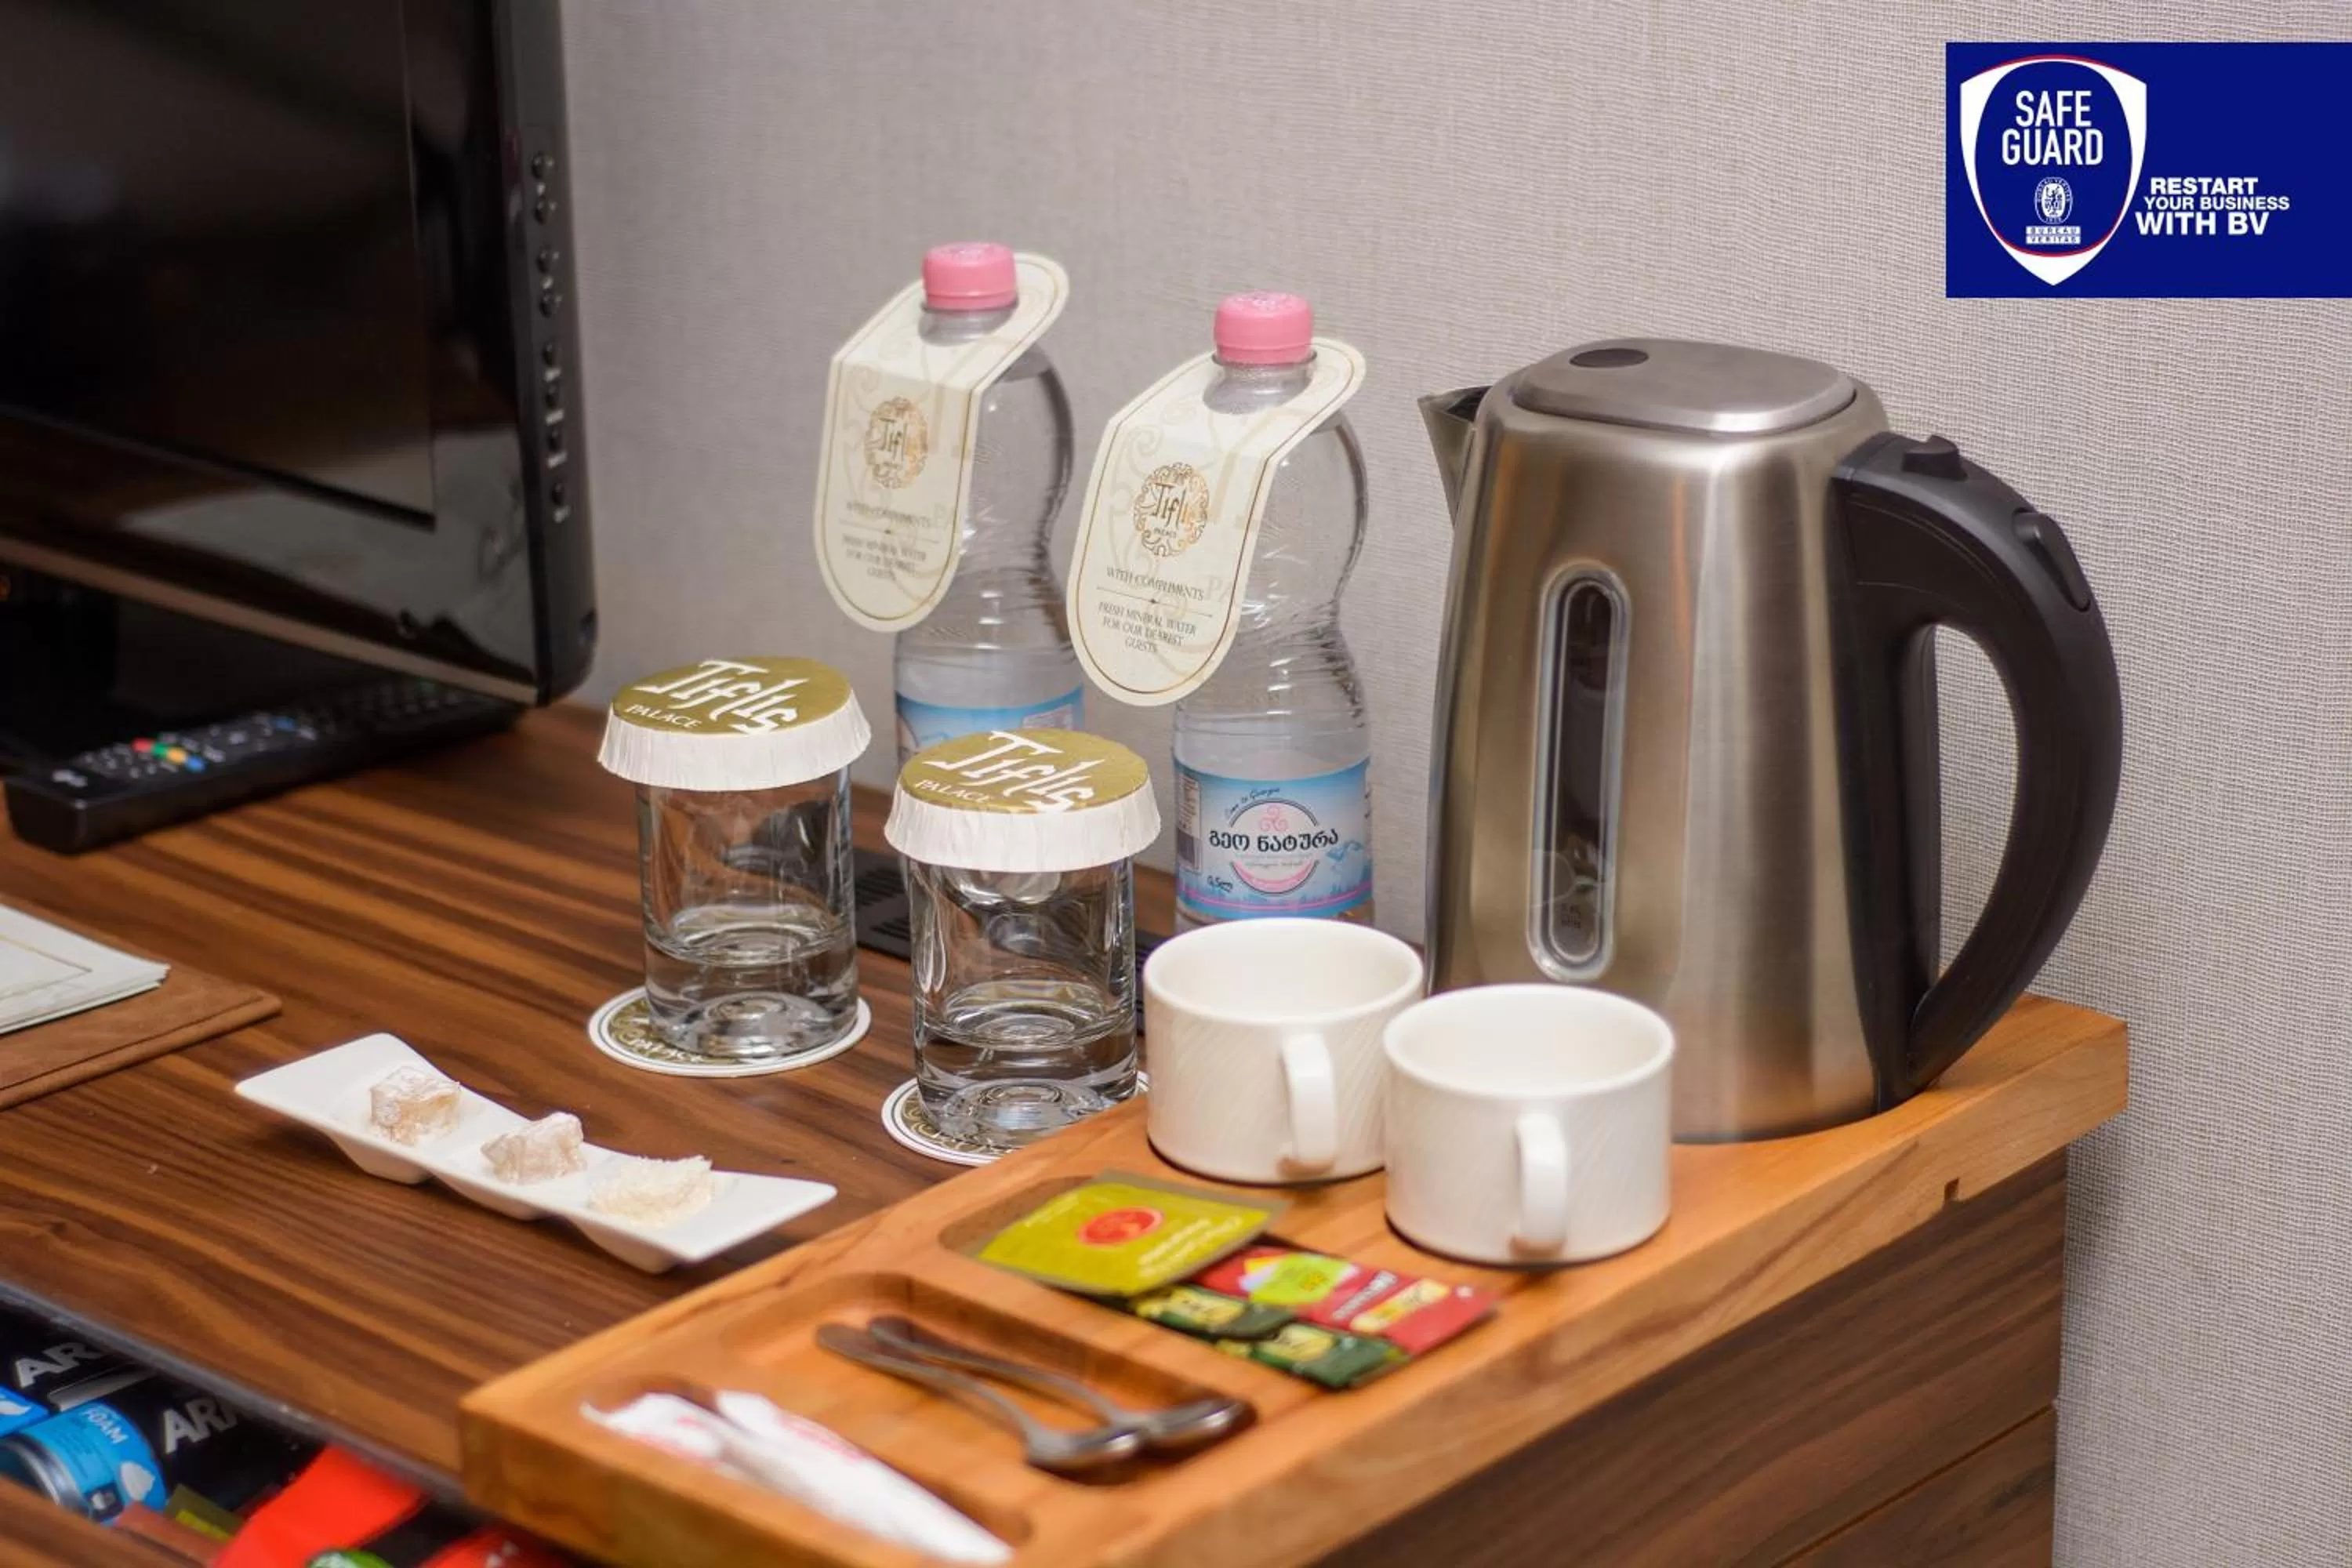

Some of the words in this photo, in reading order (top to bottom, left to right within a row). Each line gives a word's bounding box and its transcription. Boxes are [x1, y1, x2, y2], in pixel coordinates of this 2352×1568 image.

[1106, 566, 1134, 584] WITH
[625, 702, 702, 729] PALACE
[916, 779, 992, 804] PALACE
